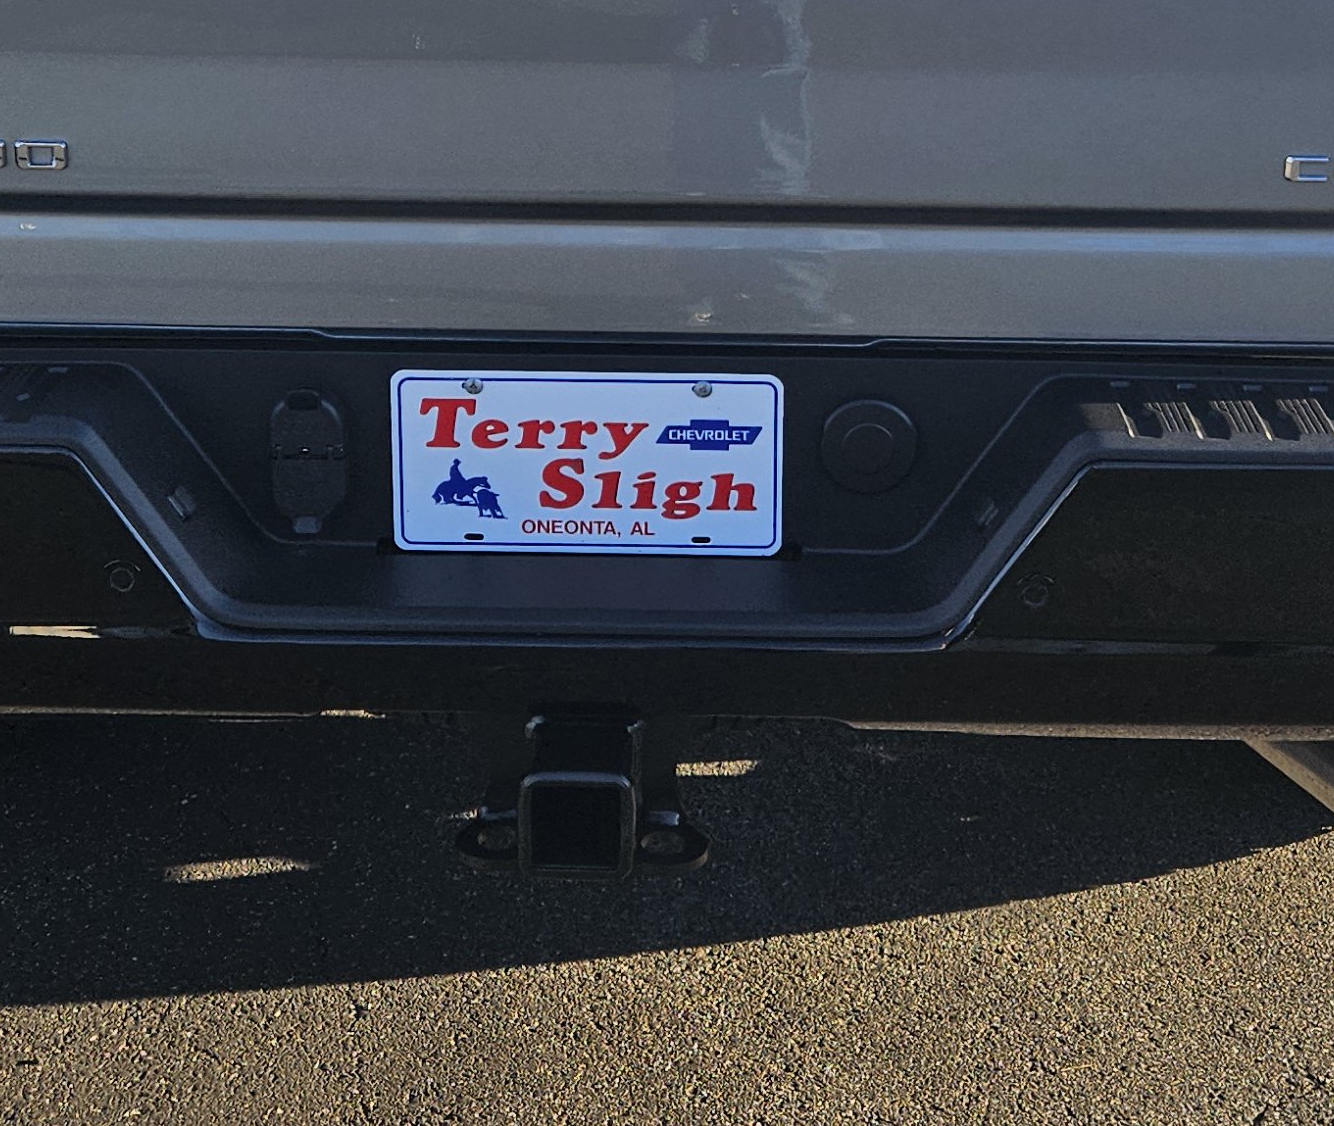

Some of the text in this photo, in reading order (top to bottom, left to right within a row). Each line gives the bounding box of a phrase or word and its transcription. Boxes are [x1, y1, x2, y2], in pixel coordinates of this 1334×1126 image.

[419, 397, 650, 460] Terry
[667, 428, 750, 443] CHEVROLET
[538, 457, 759, 521] Sligh
[521, 519, 656, 538] ONEONTA, AL
